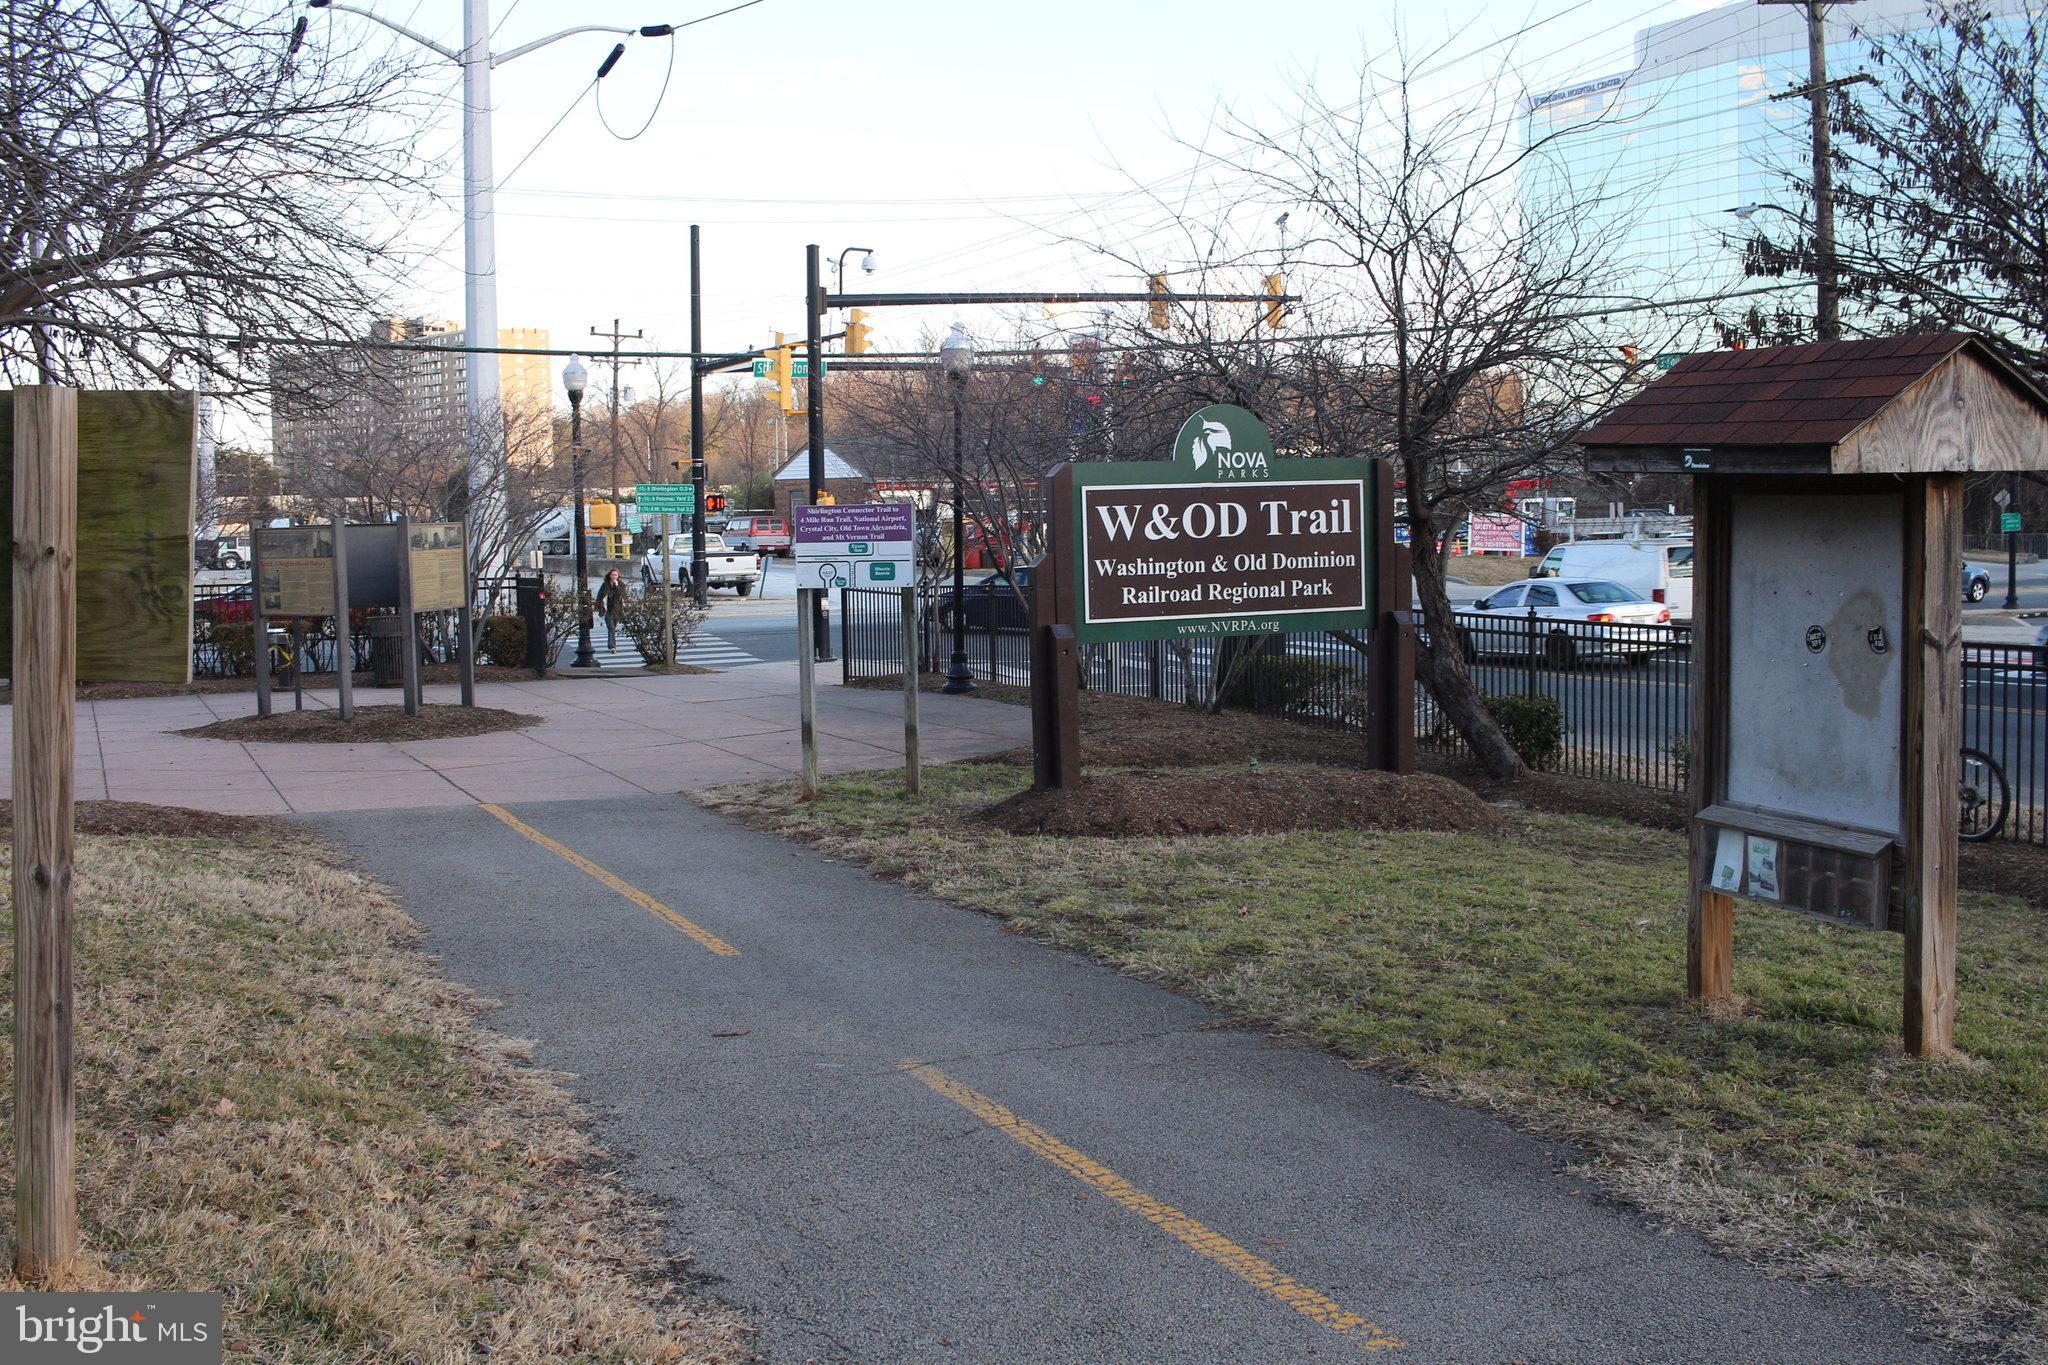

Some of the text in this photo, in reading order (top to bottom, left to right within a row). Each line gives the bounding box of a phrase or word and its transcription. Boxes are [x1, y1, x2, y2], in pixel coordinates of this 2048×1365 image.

[1567, 84, 1596, 97] HOSPITAL
[1596, 78, 1621, 90] CENTER
[1217, 451, 1267, 469] NOVA
[1218, 469, 1270, 479] PARKS
[807, 507, 842, 515] Shirlington
[881, 515, 907, 523] Airport,
[1095, 498, 1353, 542] W&OD Trail
[800, 526, 823, 534] Crystal
[824, 526, 839, 534] City,
[1094, 550, 1356, 578] Washington & Old Dominion
[1121, 578, 1334, 605] Railroad Regional Park
[1177, 618, 1280, 635] www.NVRPA.org
